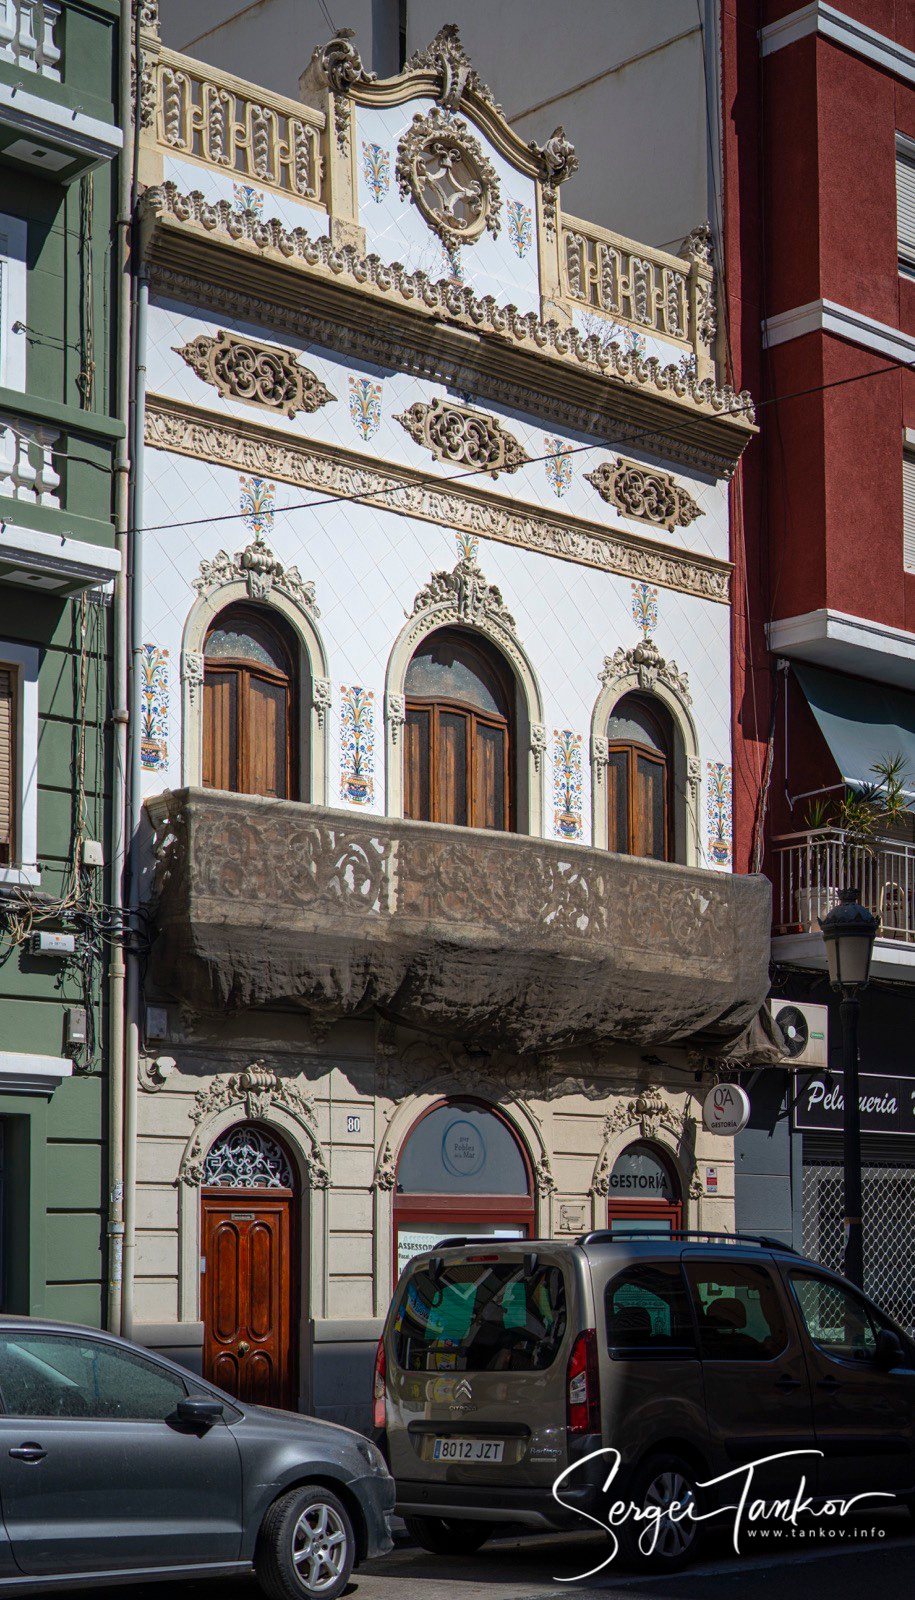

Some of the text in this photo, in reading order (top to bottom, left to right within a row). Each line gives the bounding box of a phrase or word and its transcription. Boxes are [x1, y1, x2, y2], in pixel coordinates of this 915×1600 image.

[808, 1081, 898, 1115] Peluueria
[348, 1117, 360, 1132] 80
[610, 1172, 668, 1189] GESTORÍA
[442, 1442, 501, 1459] 8012 JZT
